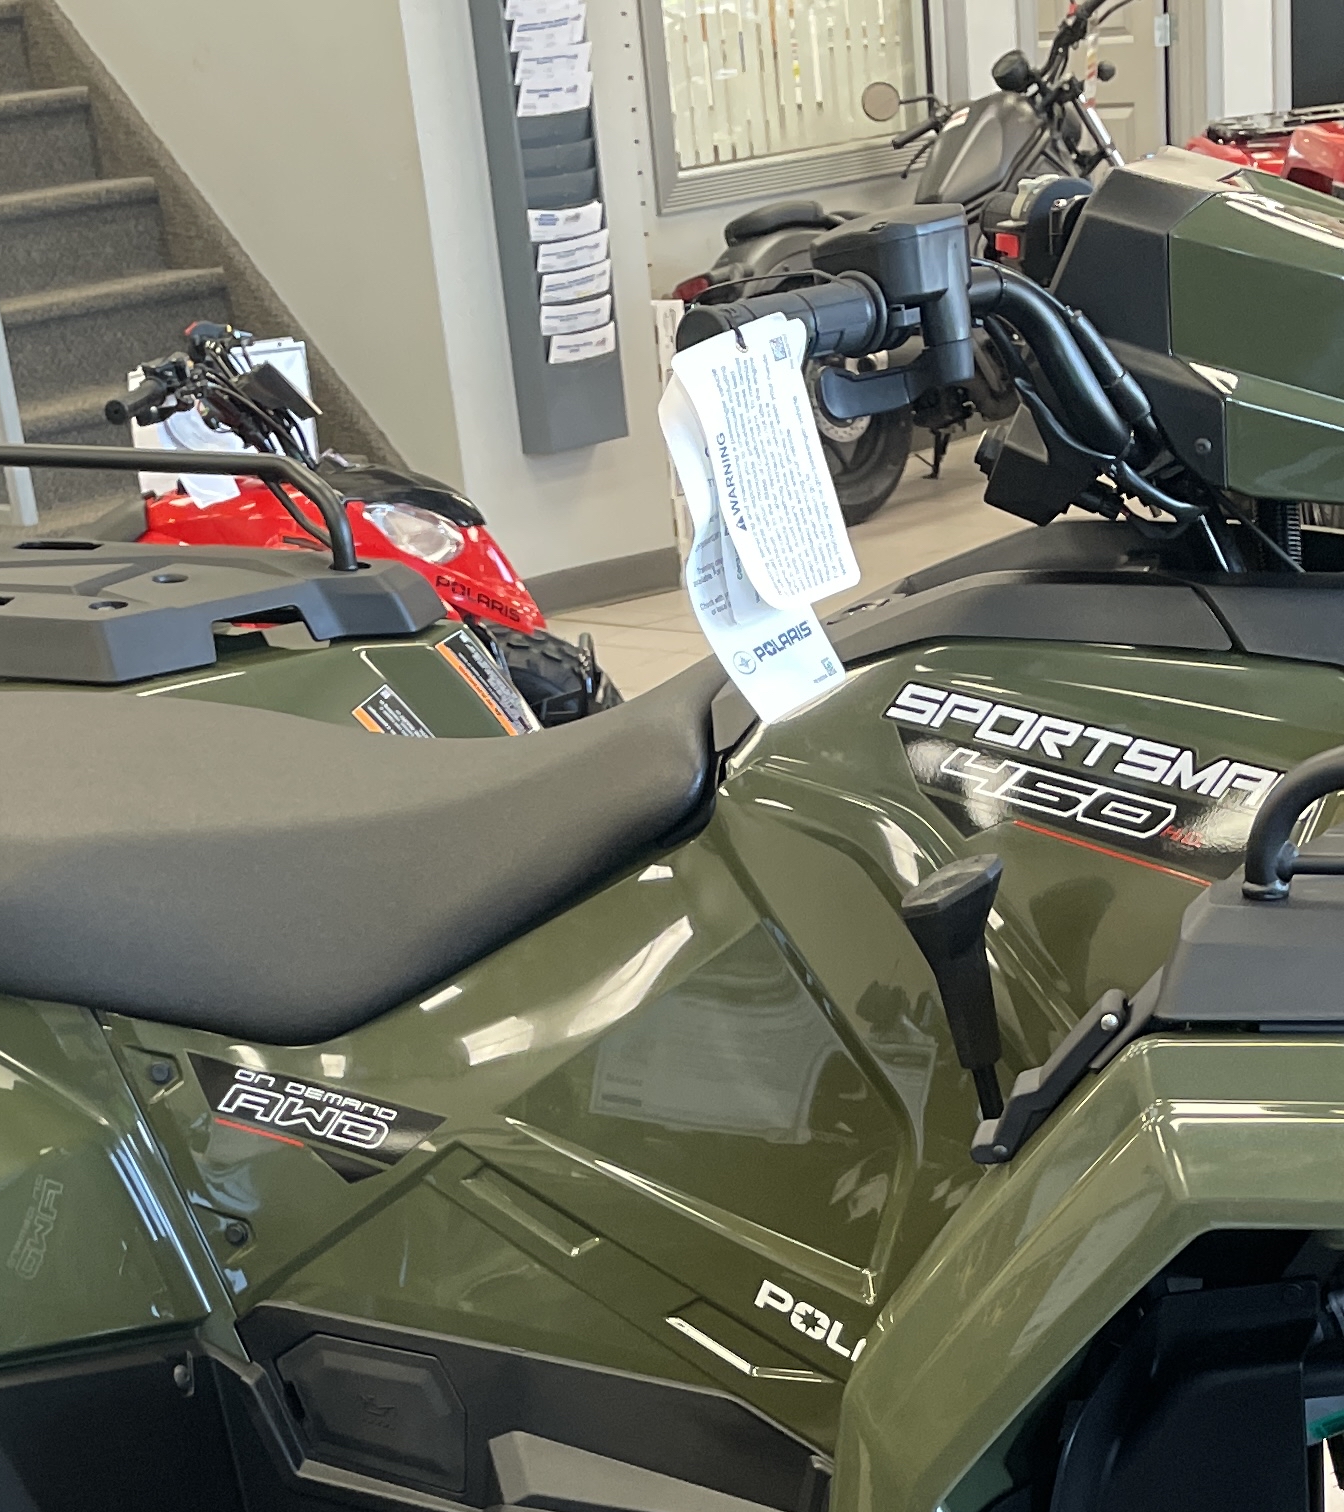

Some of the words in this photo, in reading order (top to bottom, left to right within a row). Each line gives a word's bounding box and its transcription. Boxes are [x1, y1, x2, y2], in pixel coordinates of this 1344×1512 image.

[715, 432, 741, 516] WARNING
[436, 575, 521, 622] POLARIS
[753, 621, 812, 662] POLARIS
[940, 746, 1177, 839] 450
[217, 1083, 389, 1149] AWD
[284, 1082, 397, 1121] DEMAND
